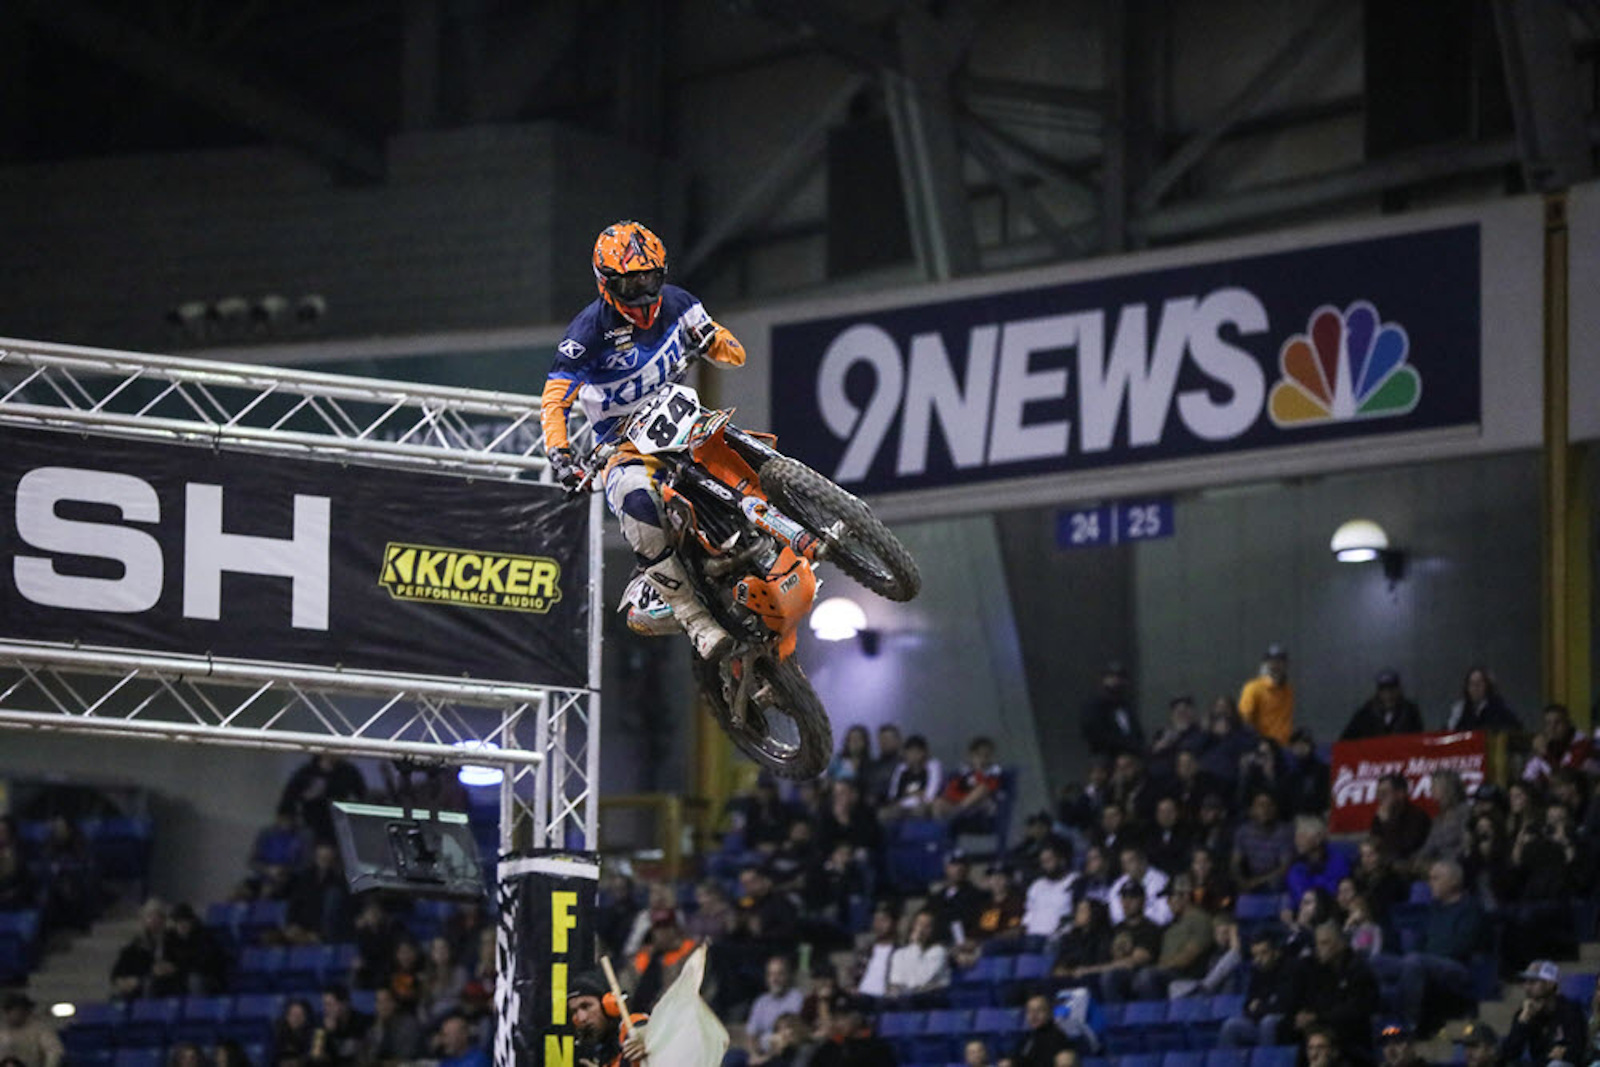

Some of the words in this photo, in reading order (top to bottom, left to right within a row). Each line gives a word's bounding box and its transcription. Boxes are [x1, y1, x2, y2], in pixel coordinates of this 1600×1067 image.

[817, 288, 1269, 483] 9NEWS
[646, 391, 697, 448] 84
[13, 466, 332, 631] SH
[1070, 511, 1100, 543] 24
[1128, 505, 1161, 538] 25
[396, 584, 498, 605] PERFORMANCE
[502, 594, 545, 609] AUDIO
[416, 550, 557, 598] KICKER
